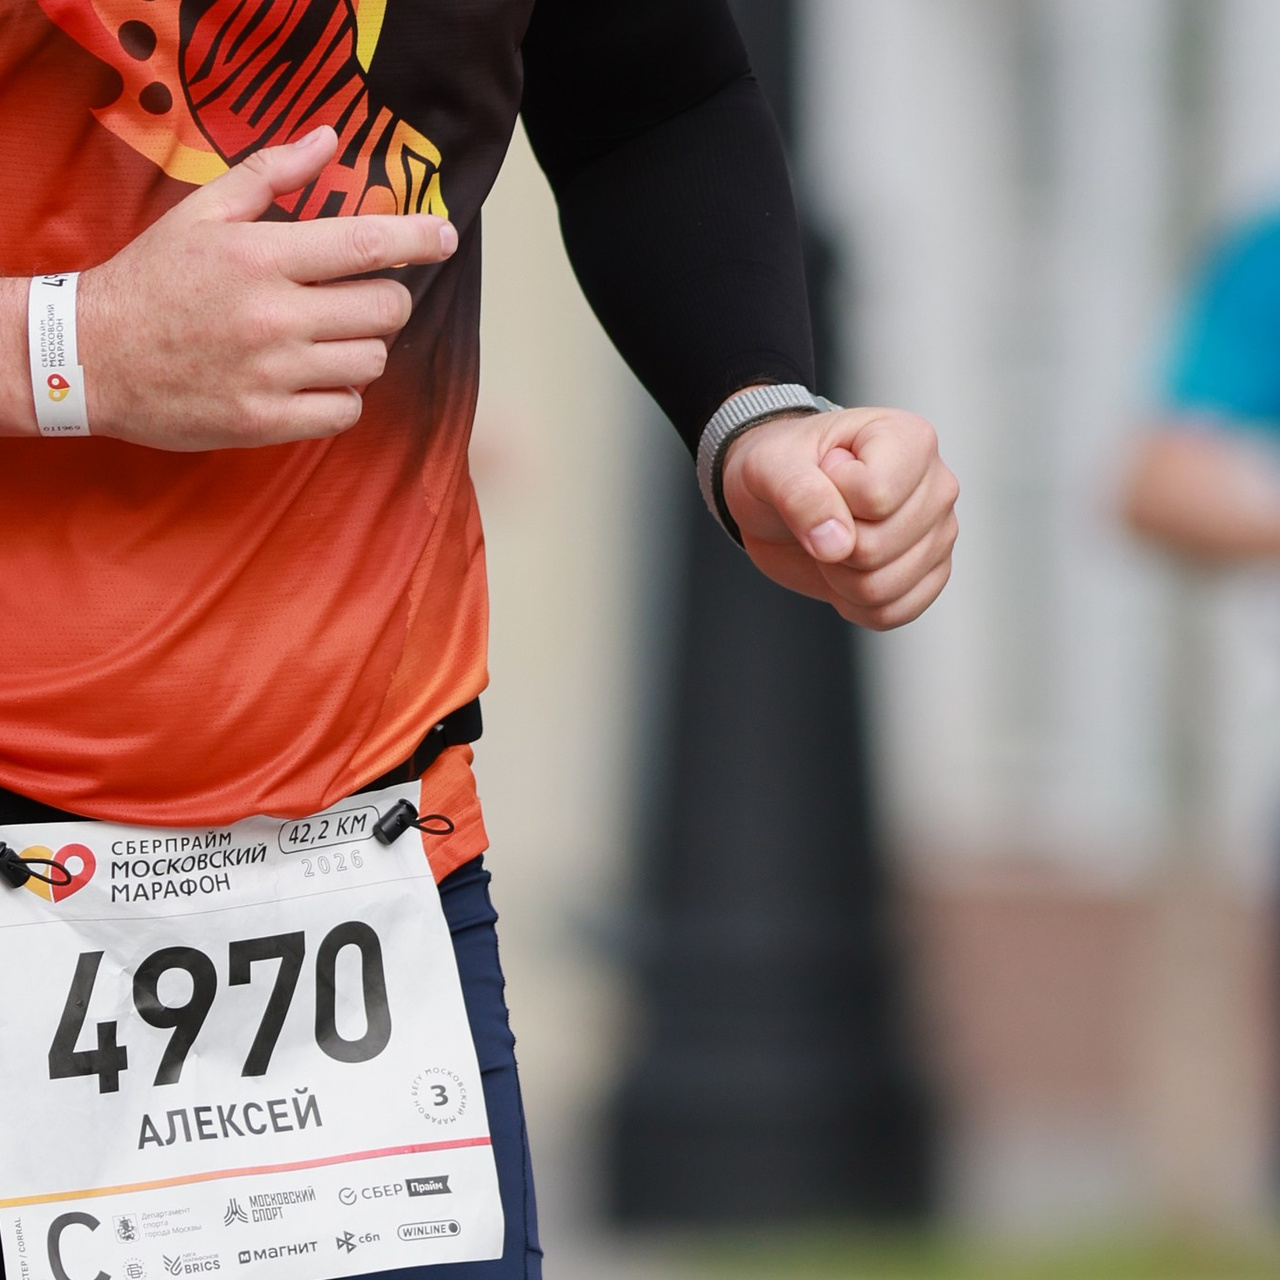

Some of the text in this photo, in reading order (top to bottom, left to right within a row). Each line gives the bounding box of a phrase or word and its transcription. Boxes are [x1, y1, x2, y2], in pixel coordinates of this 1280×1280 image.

[40, 319, 48, 368] СБЕРПРАЙМ
[47, 303, 56, 367] МОСКОВСКИЙ
[56, 318, 65, 367] МАРАФОН
[111, 831, 232, 856] СБЕРПРАЙМ
[288, 813, 368, 846] 42,2 КМ
[111, 843, 267, 879] МОСКОВСКИЙ
[301, 850, 364, 877] 2026
[111, 872, 231, 903] МАРАФОН
[48, 920, 392, 1095] 4970
[430, 1084, 449, 1106] 3
[138, 1087, 323, 1150] АЛЕКСЕЙ
[249, 1185, 317, 1209] МОСКОВСКИЙ
[361, 1180, 444, 1201] СБЕР Прайм
[251, 1206, 284, 1223] СПОРТ
[14, 1217, 26, 1253] CORRAL
[403, 1224, 447, 1238] WINLINE
[184, 1259, 221, 1274] BRICS
